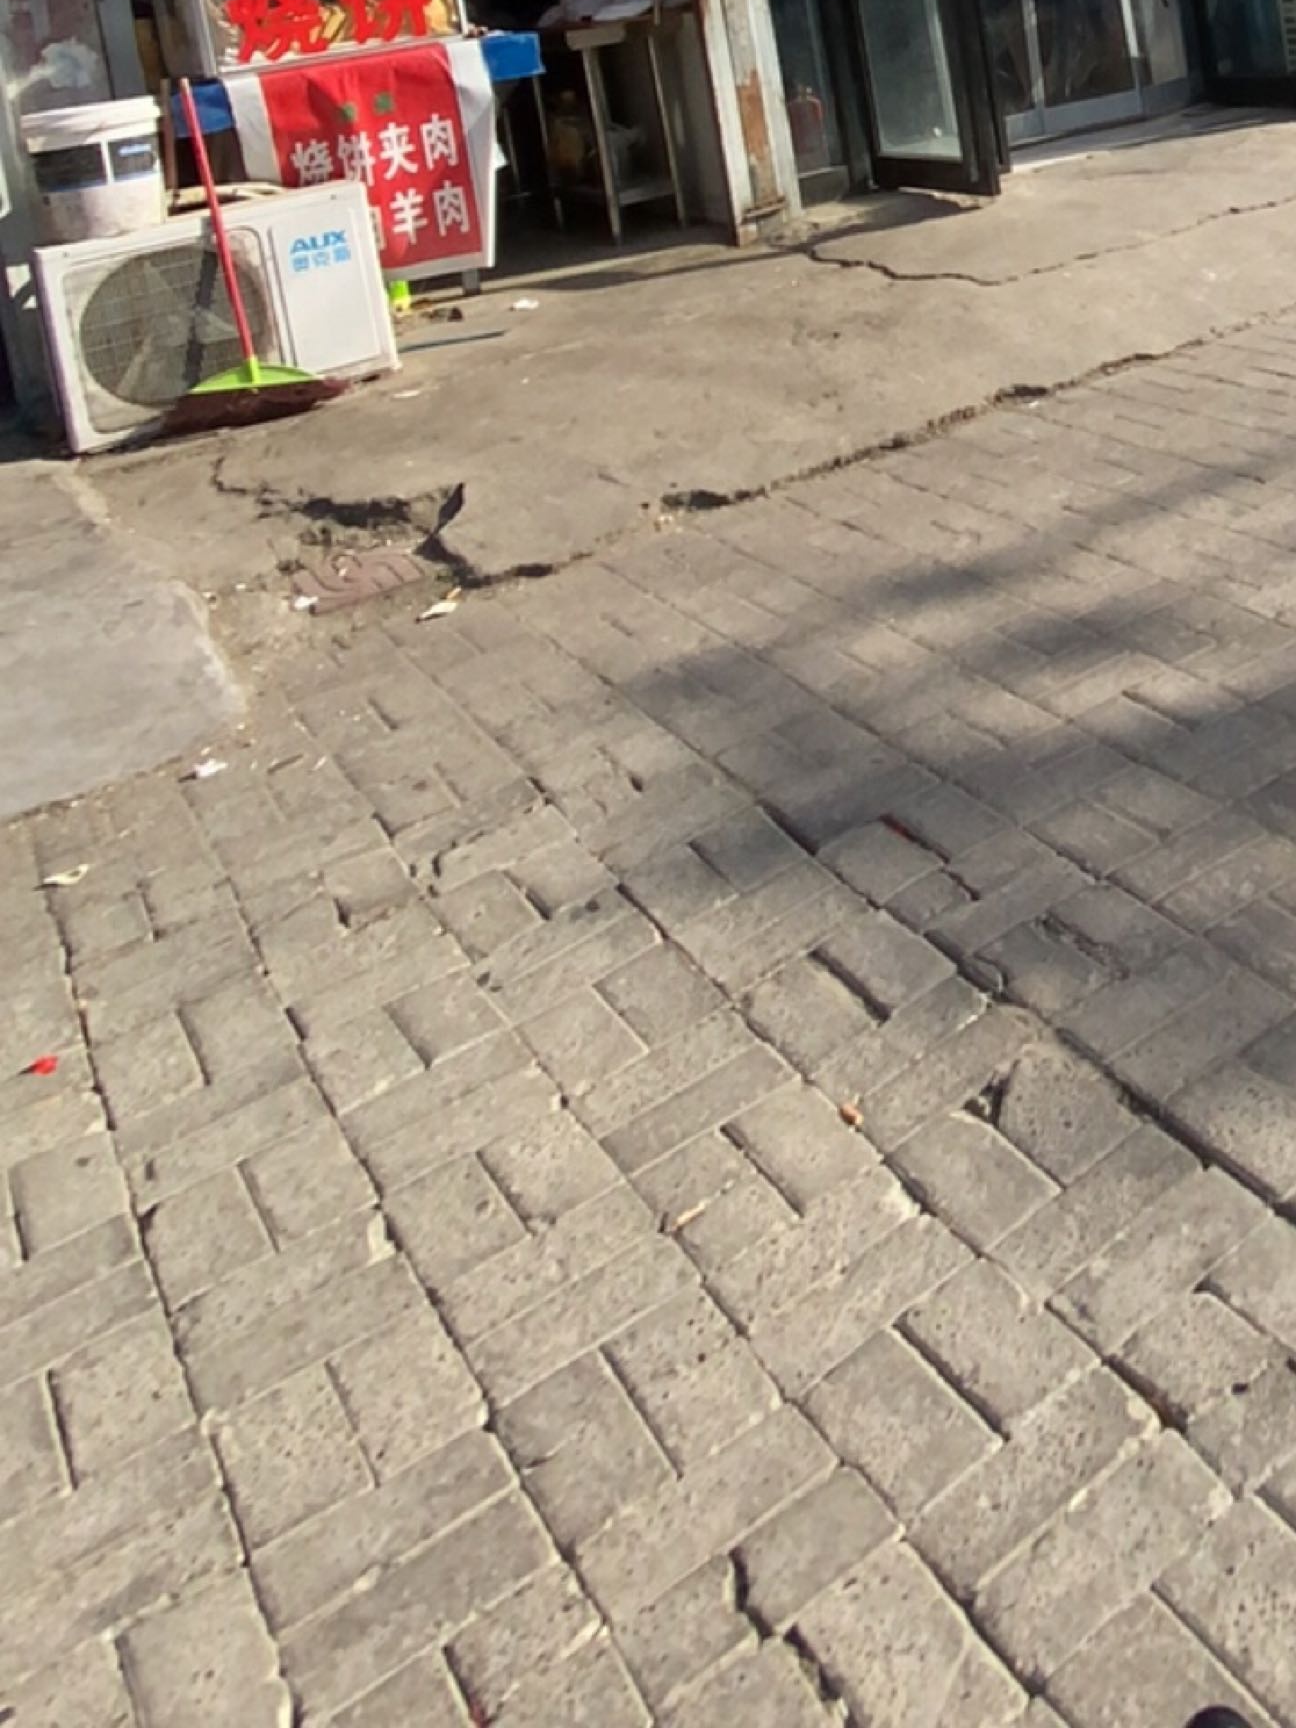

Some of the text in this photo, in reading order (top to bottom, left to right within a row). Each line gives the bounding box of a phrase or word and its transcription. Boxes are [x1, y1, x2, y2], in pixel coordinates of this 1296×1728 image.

[290, 112, 460, 187] 烧饼夹肉
[290, 229, 347, 254] AUX
